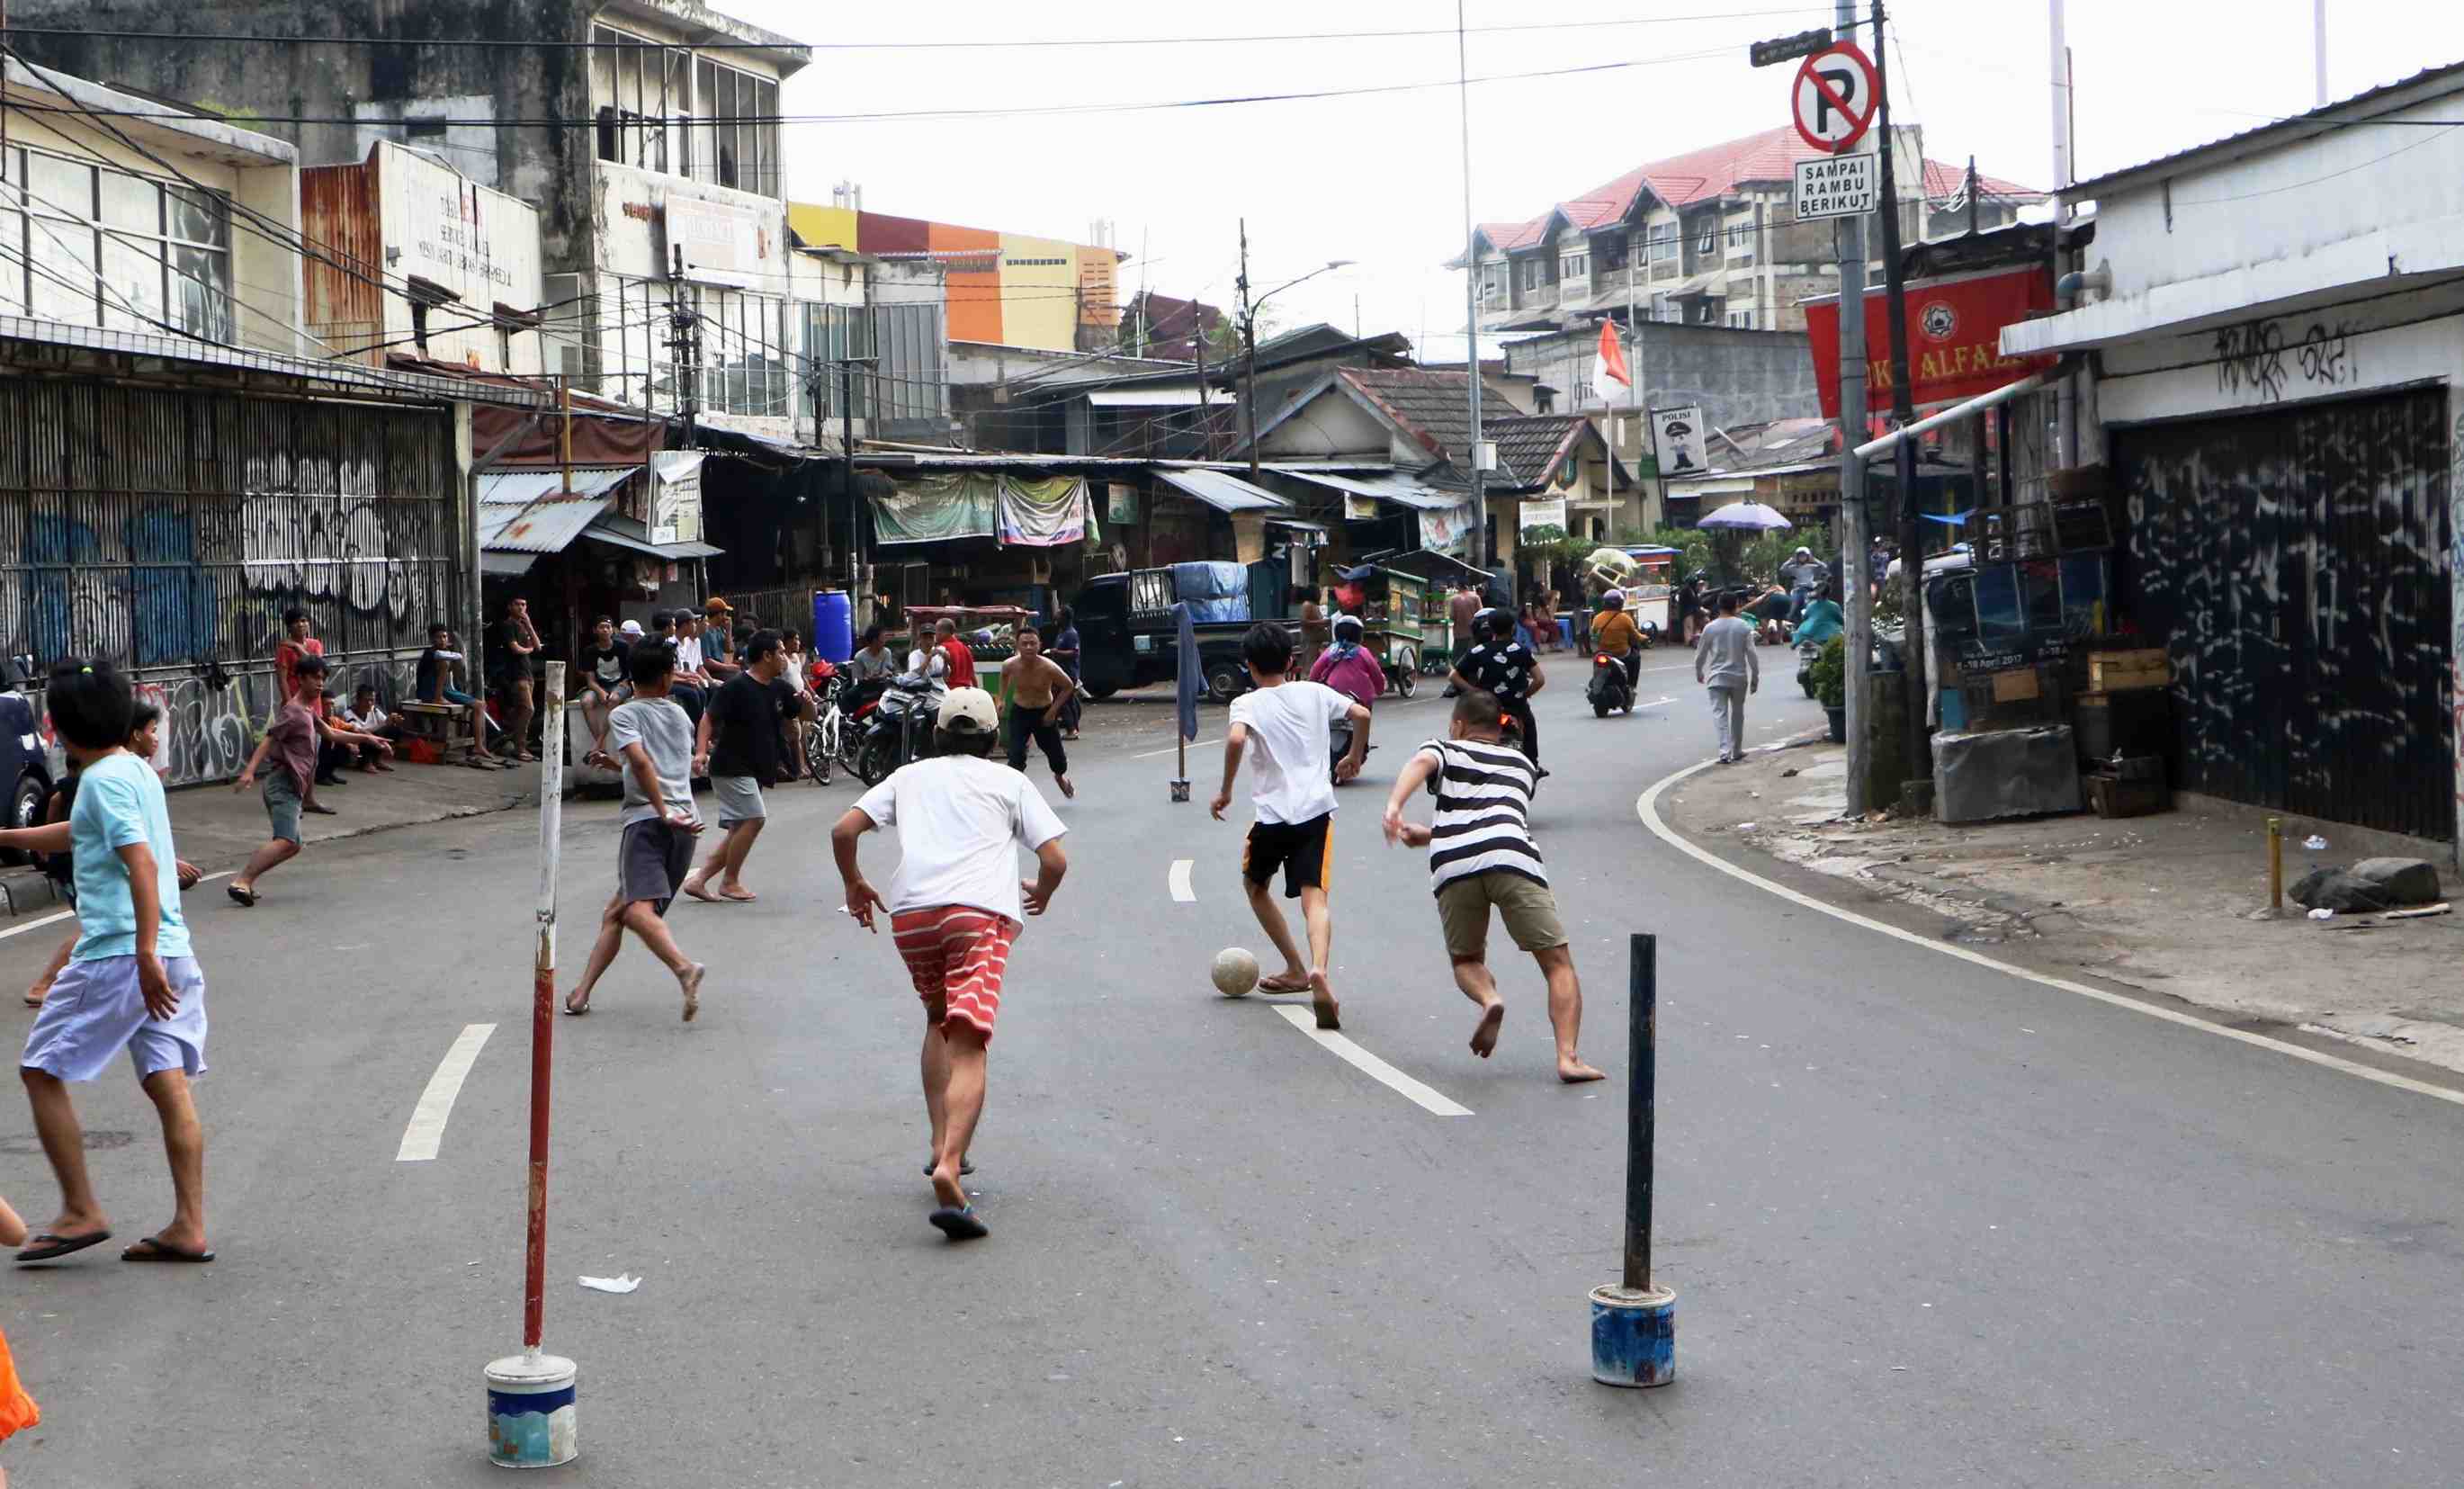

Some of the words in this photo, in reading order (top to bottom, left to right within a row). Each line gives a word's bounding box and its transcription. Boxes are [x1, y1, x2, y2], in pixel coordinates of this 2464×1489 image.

[1805, 160, 1864, 181] SAMPAI
[1805, 175, 1864, 196] RAMBU
[1800, 193, 1870, 213] BERIKUT
[1662, 411, 1690, 422] POLISI
[2002, 653, 2023, 666] 2017
